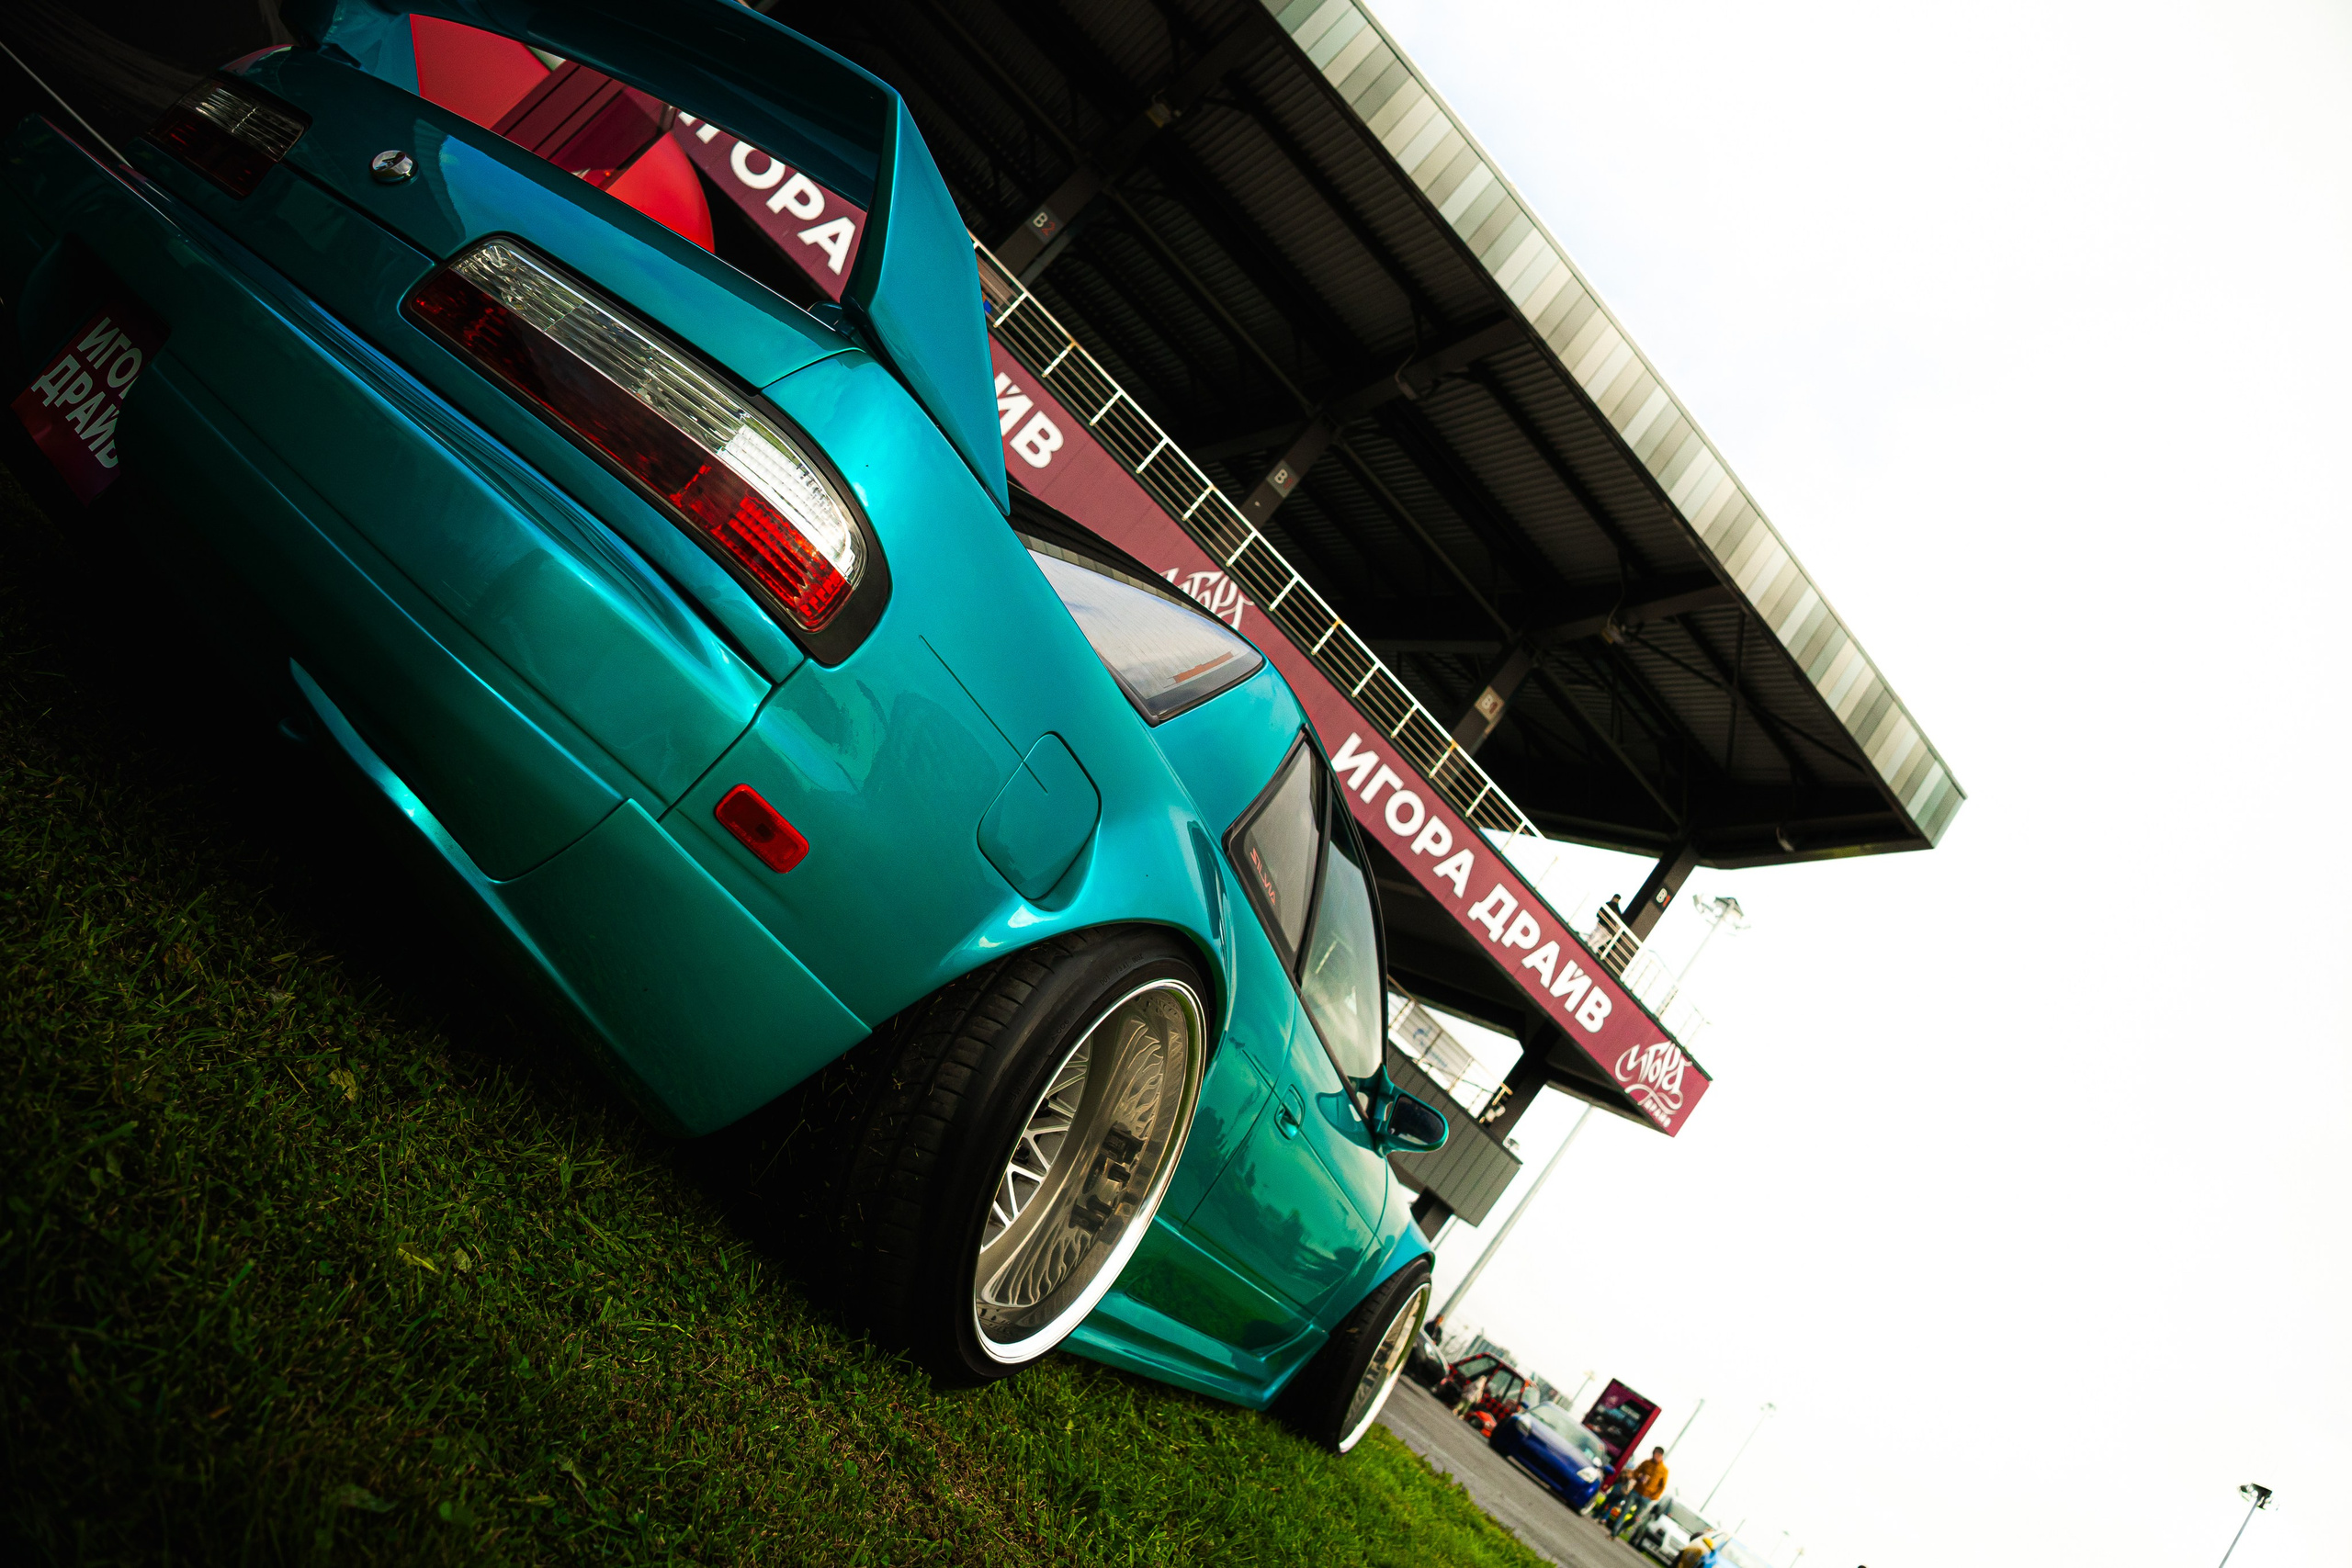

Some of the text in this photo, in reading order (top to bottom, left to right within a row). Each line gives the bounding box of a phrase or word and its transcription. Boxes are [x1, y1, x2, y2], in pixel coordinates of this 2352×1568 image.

[77, 317, 142, 399] ИГО
[1331, 732, 1612, 1033] ИГОРА ДРАЙВ
